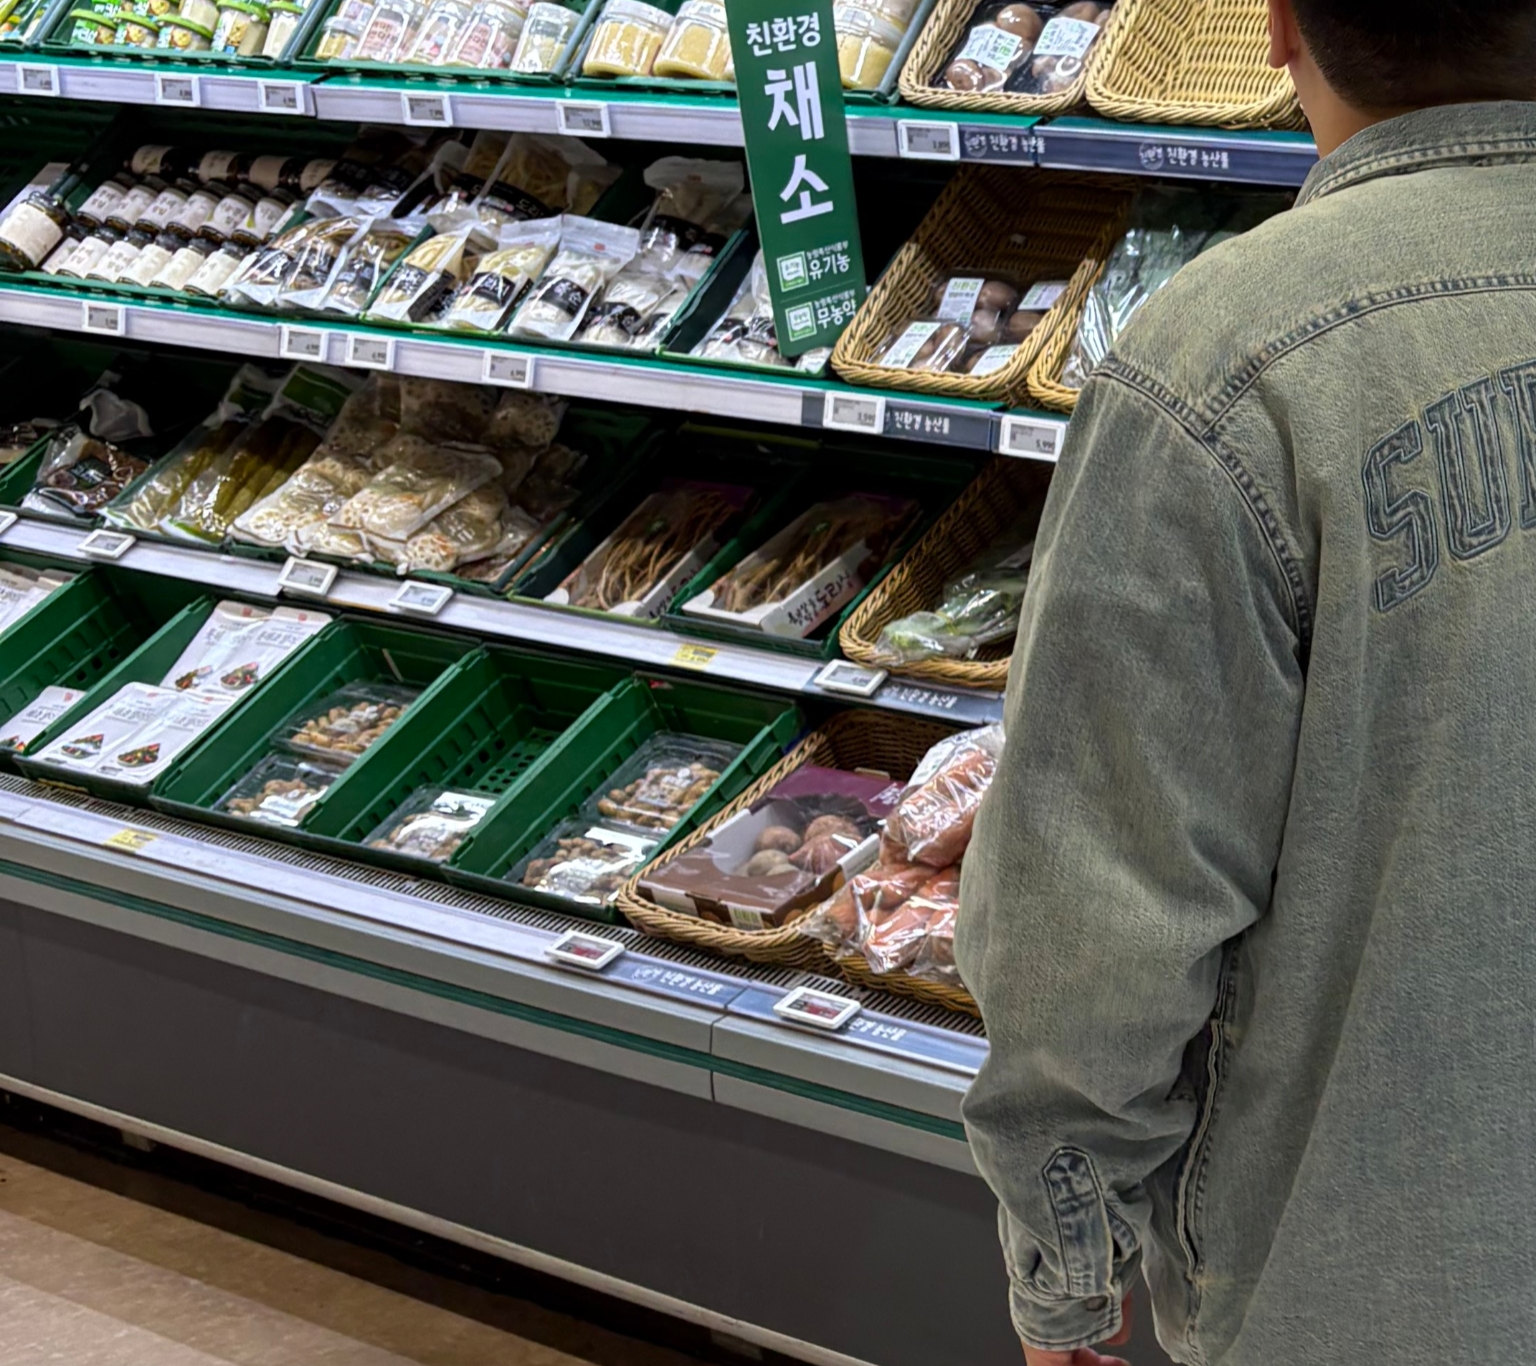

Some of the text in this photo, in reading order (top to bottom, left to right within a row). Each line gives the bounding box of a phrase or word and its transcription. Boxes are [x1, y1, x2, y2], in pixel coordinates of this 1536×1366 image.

[745, 11, 821, 57] 친환경
[1166, 146, 1229, 169] 친환경 농산물
[809, 252, 851, 281] 유기농
[817, 298, 857, 329] 무농약
[894, 411, 921, 430] 친환경
